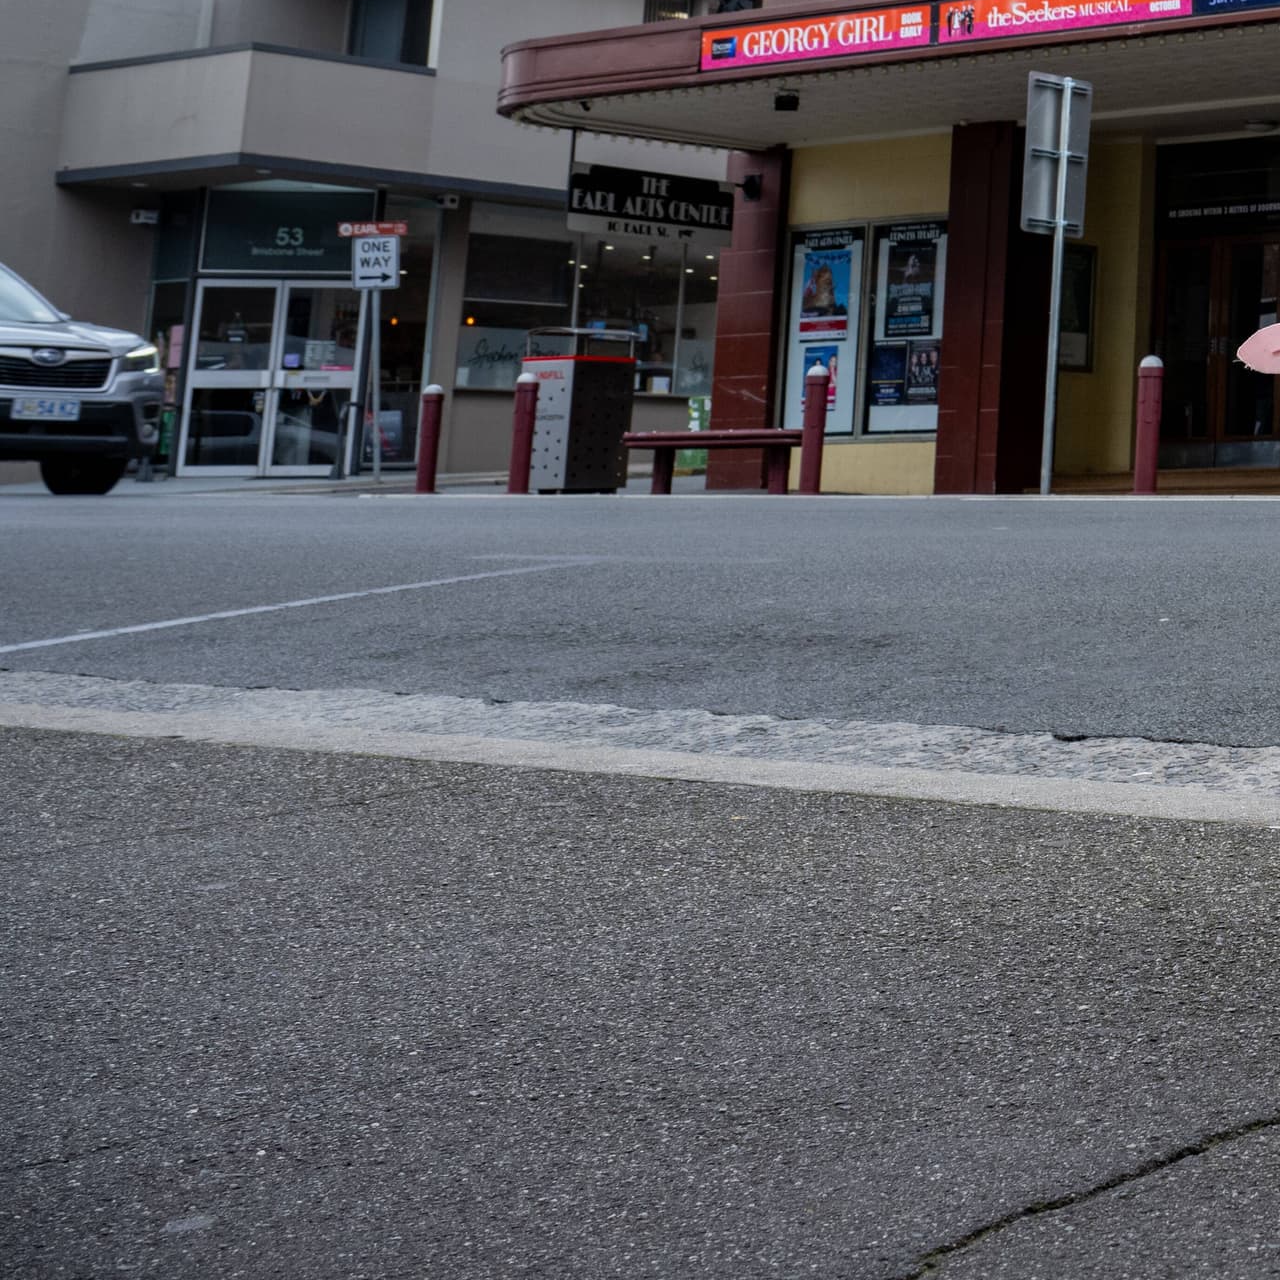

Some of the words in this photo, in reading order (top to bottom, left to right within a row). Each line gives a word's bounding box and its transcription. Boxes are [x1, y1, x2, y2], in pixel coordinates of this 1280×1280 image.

[1078, 0, 1132, 18] MUSICAL
[901, 11, 922, 25] BOOK
[742, 22, 838, 58] GEORGY
[837, 15, 892, 47] GIRL
[900, 25, 923, 38] EARLY
[641, 175, 671, 197] THE
[572, 187, 617, 214] EARL
[622, 195, 665, 219] ARTS
[668, 200, 730, 226] CENTRE
[275, 227, 304, 246] 53
[353, 223, 379, 234] EARL
[361, 240, 391, 253] ONE
[359, 256, 392, 268] WAY
